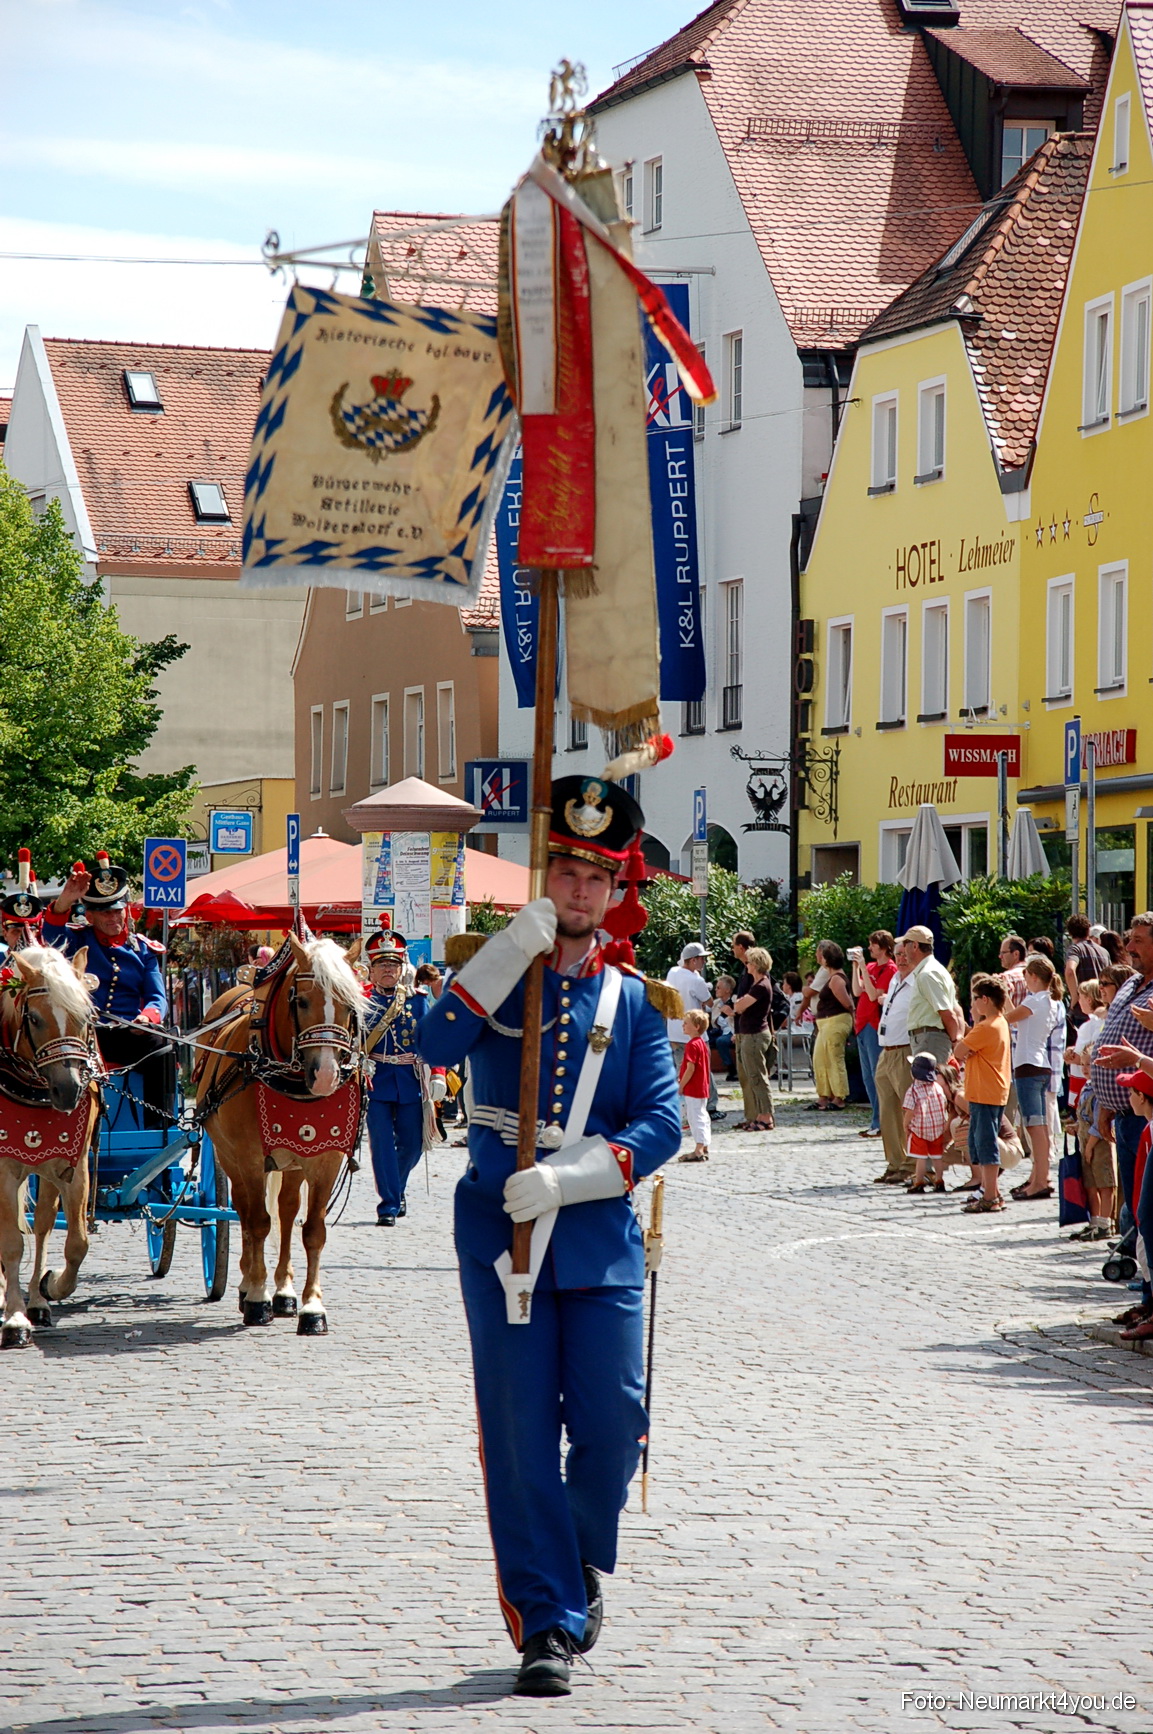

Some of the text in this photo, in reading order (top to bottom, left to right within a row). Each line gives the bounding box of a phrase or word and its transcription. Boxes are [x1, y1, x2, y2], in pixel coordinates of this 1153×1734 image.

[316, 328, 415, 353] Historische
[320, 497, 400, 516] Artillerie
[292, 512, 394, 537] Wolkersdorf
[665, 440, 696, 648] K&L RUPPERT
[896, 529, 1016, 590] HOTEL Lehmeier
[948, 748, 1017, 763] WISSMAH
[1067, 728, 1078, 778] P
[473, 767, 521, 810] K&L
[888, 775, 958, 809] Restaurant
[695, 796, 704, 834] P
[289, 820, 298, 855] P
[148, 886, 182, 902] TAXI
